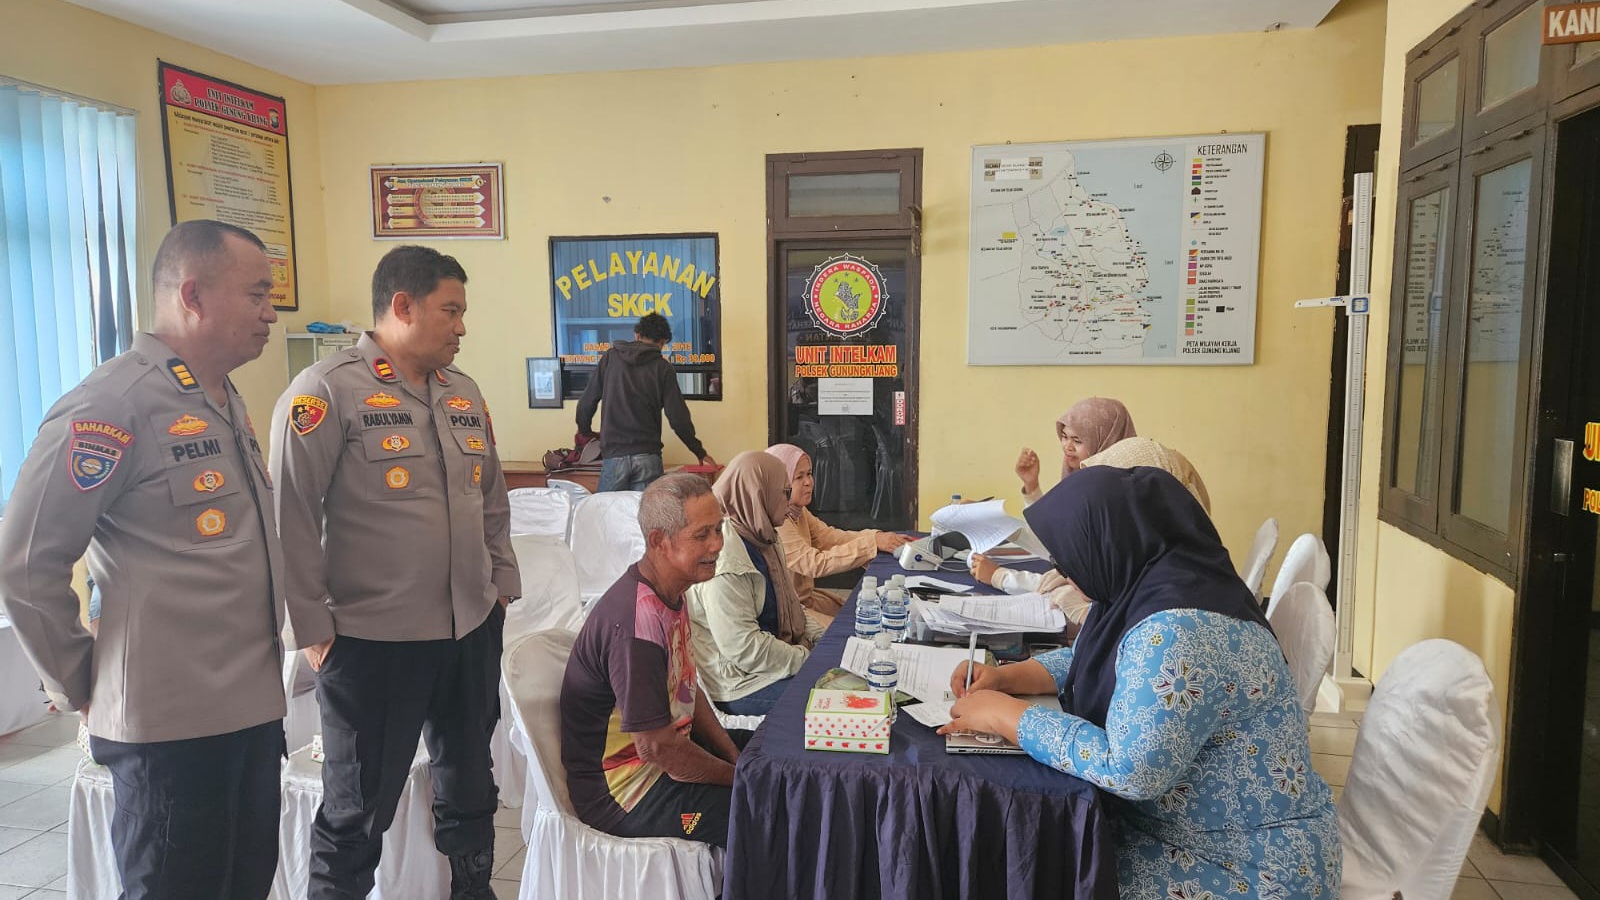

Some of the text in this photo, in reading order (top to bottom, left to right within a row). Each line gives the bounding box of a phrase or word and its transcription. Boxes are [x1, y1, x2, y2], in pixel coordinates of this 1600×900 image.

[1197, 144, 1248, 155] KETERANGAN
[555, 250, 716, 300] PELAYANAN
[814, 263, 877, 292] INDERA WASPADA
[608, 292, 673, 317] SKCK
[814, 301, 877, 329] NEGARA RAHARJA
[675, 354, 687, 363] Rp
[795, 345, 897, 364] UNIT INTELKAM
[795, 364, 897, 377] POLSEK GUNUNGKIJANG
[450, 415, 481, 428] POLRI
[75, 422, 131, 444] BAHARKAM
[171, 438, 222, 462] PELMI
[686, 812, 702, 835] adidas
